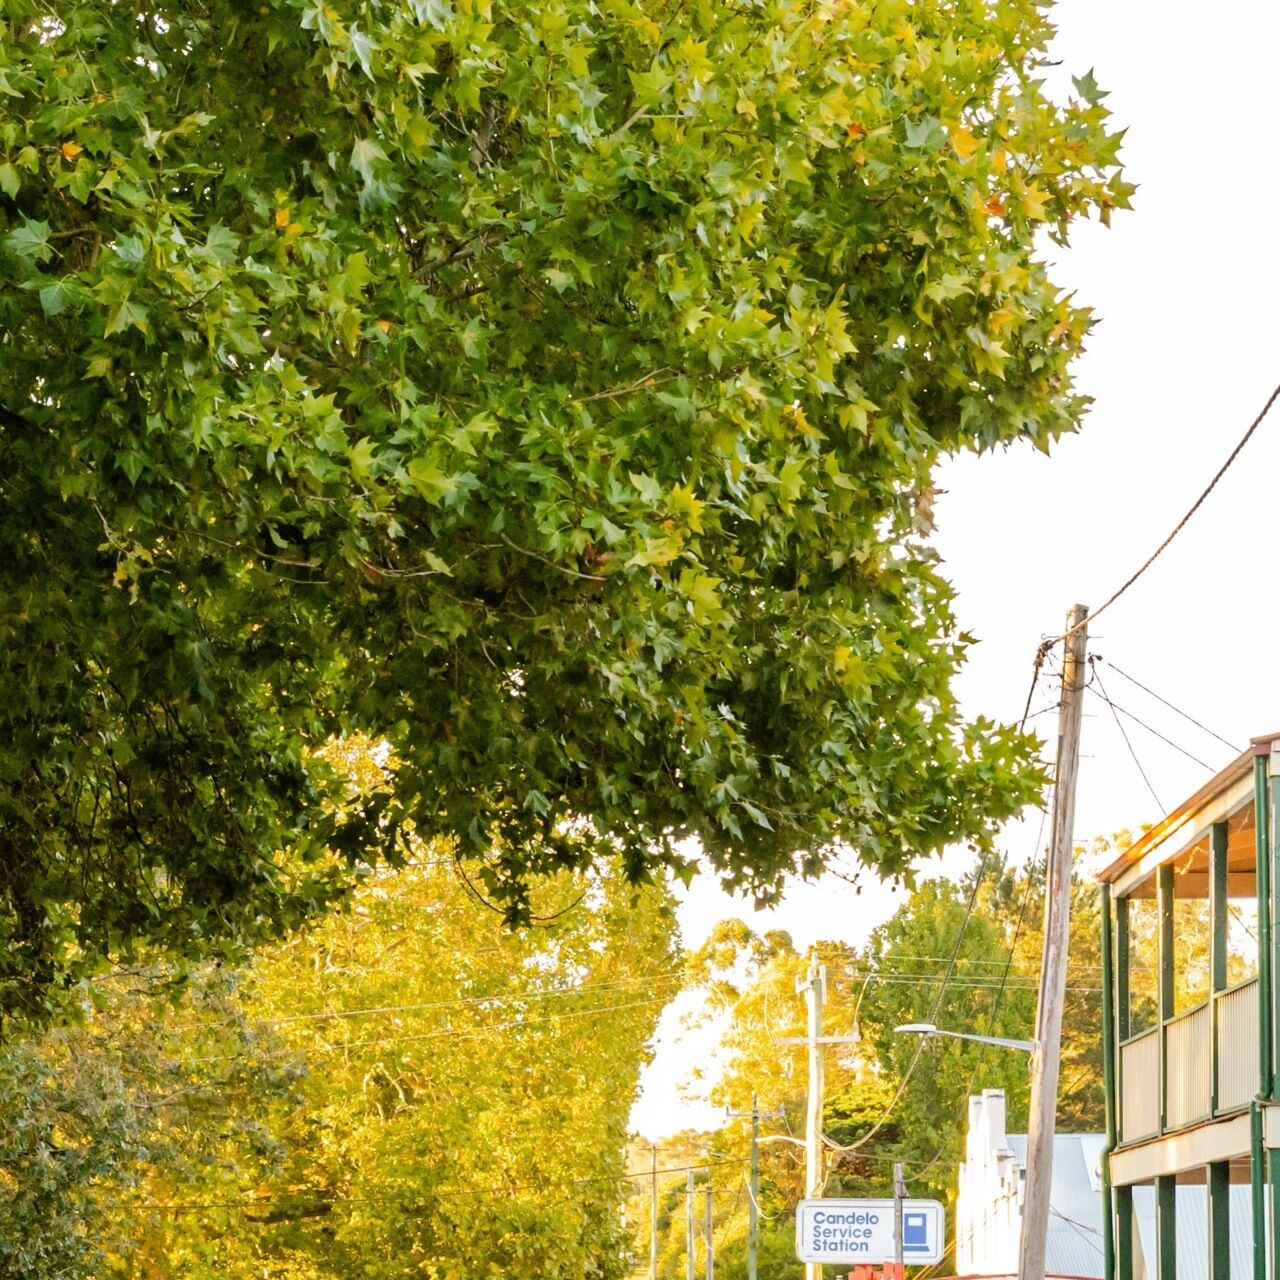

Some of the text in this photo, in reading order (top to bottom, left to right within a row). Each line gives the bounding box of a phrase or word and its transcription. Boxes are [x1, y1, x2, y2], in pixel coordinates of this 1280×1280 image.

[813, 1211, 879, 1225] Candelo
[813, 1225, 873, 1239] Service
[812, 1239, 869, 1252] Station
